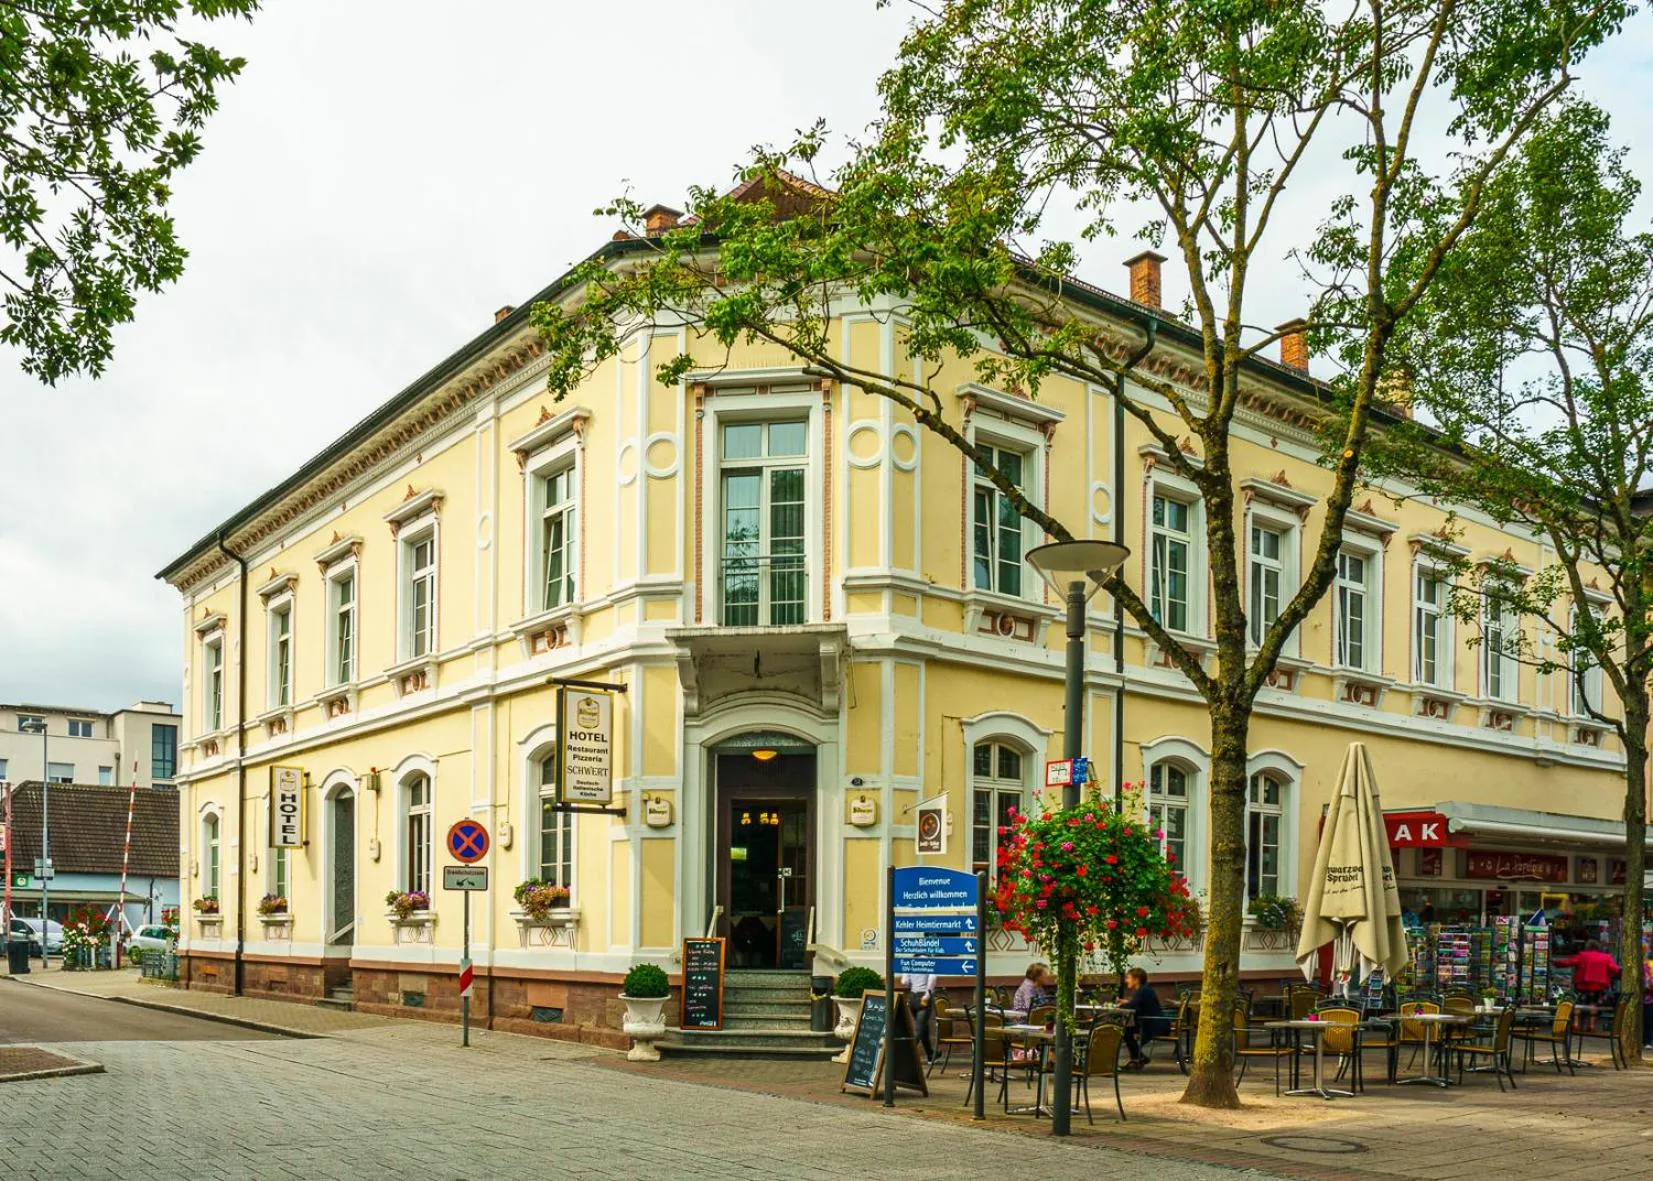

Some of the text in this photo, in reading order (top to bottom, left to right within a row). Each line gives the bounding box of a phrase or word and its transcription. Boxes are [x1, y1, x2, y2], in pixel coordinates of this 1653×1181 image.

[569, 731, 608, 743] HOTEL
[567, 745, 609, 755] Restaurant
[573, 754, 603, 763] Pizzeria
[567, 765, 609, 777] SCHWERT
[280, 793, 297, 845] HOTEL
[918, 878, 951, 886] Bienvenue
[1327, 873, 1359, 884] Sprudel
[903, 890, 968, 900] Herzlich willkommen
[895, 920, 961, 929] Kehler Heimtiermarkt
